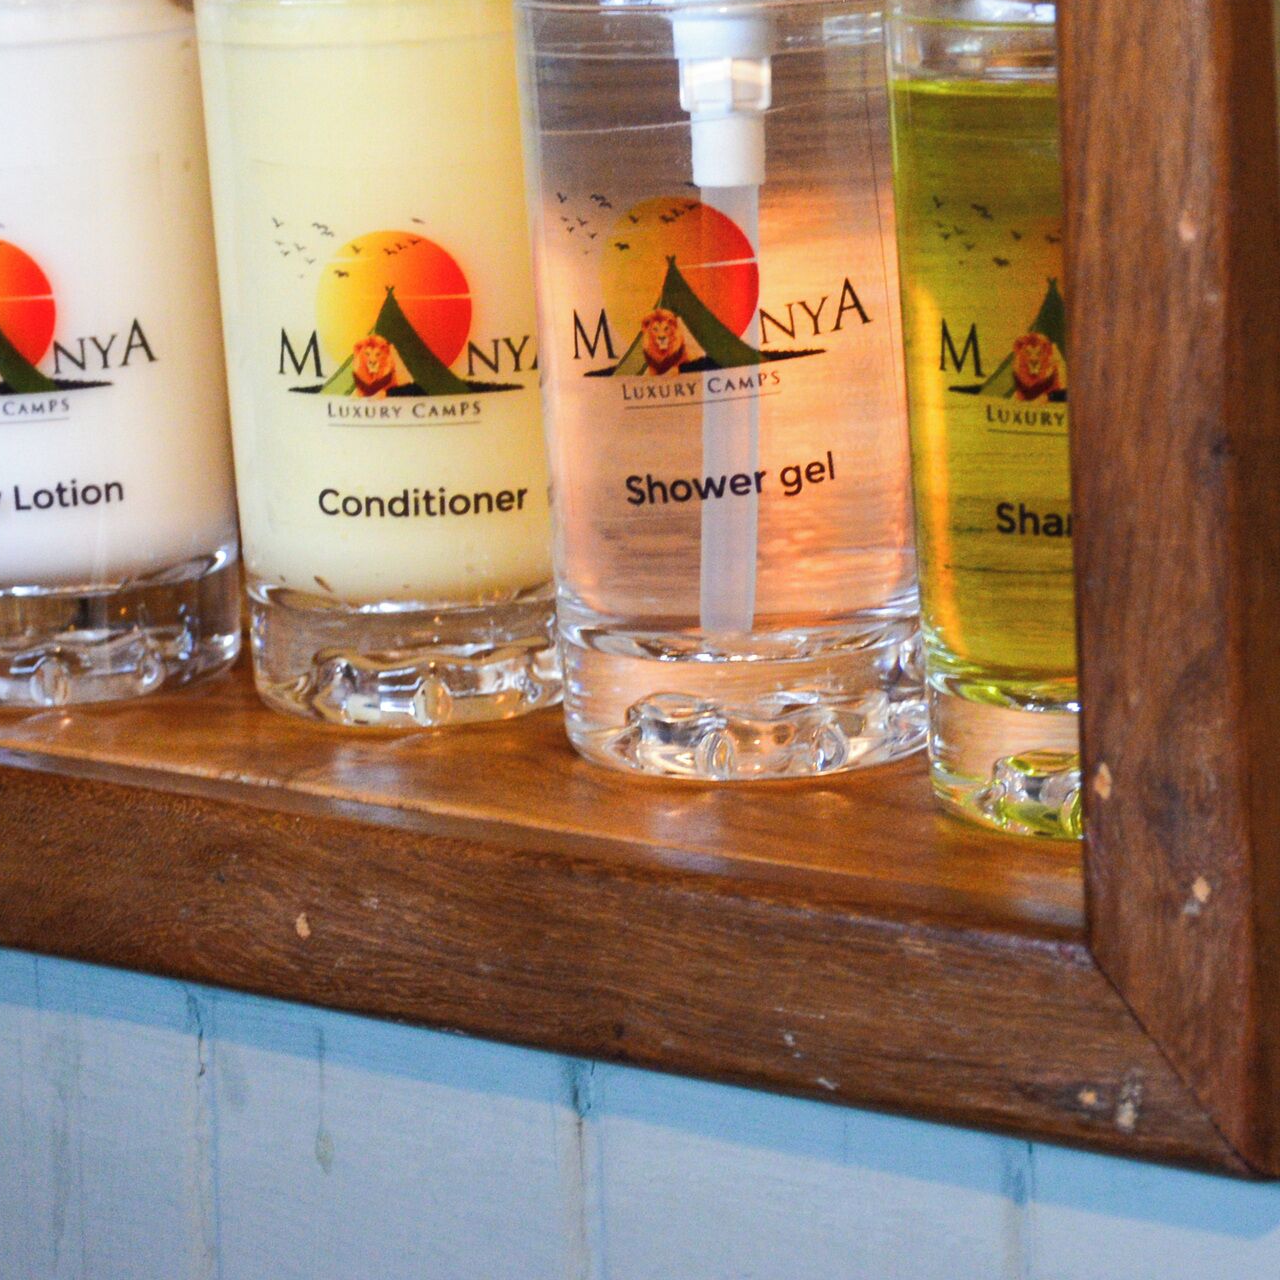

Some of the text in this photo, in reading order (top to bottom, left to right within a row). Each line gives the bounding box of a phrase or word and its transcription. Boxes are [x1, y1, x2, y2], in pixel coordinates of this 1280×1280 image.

[621, 370, 781, 401] LUXURY CAMPS
[2, 397, 70, 416] CAMPS
[327, 400, 482, 419] LUXURY CAMPS
[625, 450, 835, 506] Shower gel
[14, 478, 124, 511] Lotion
[318, 486, 528, 518] Conditioner
[996, 501, 1073, 538] Sha
